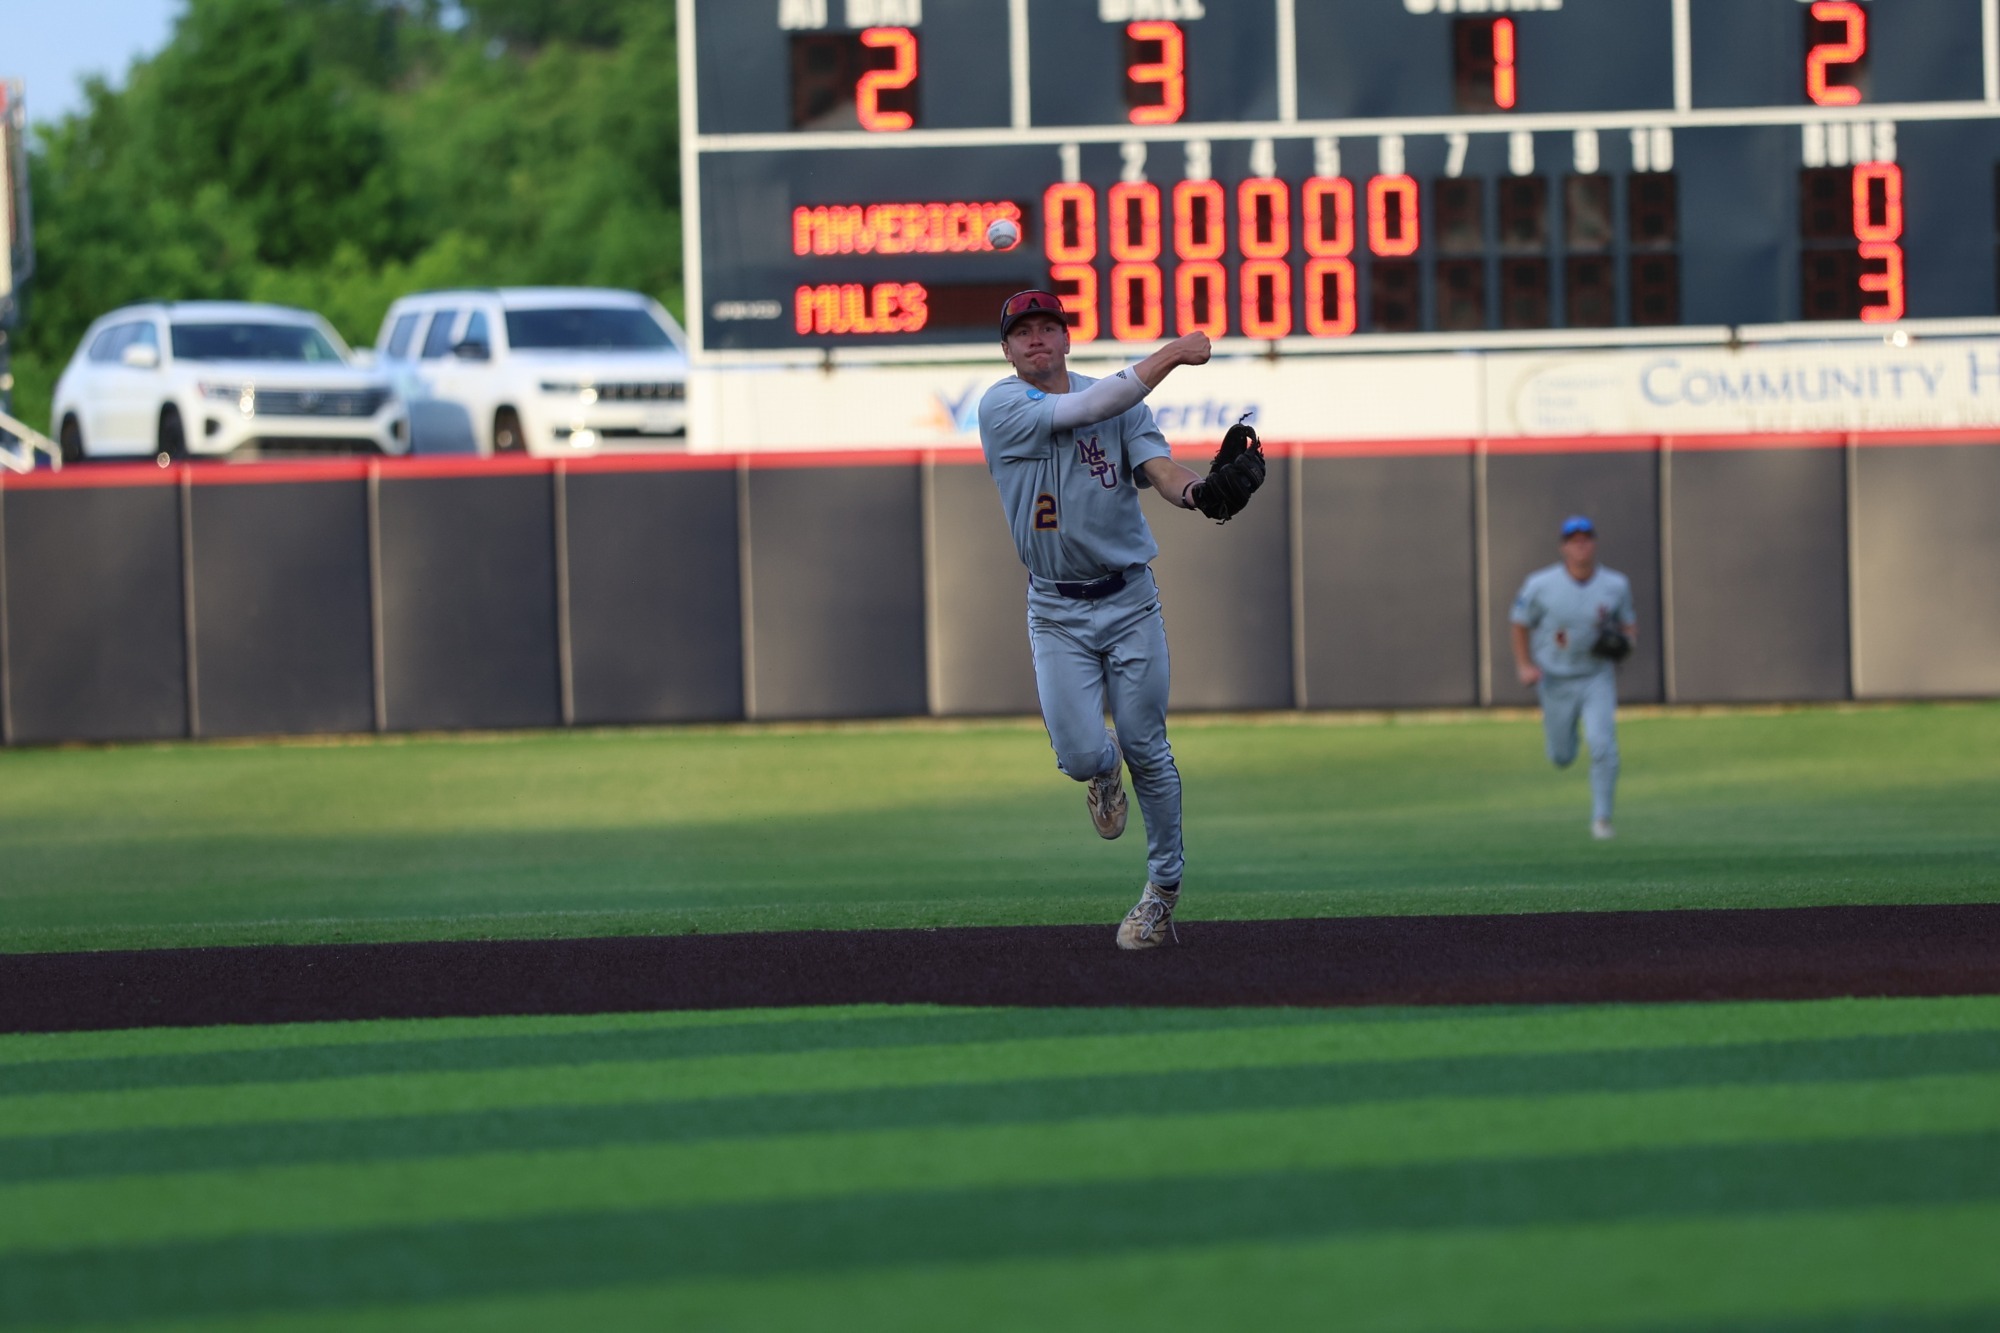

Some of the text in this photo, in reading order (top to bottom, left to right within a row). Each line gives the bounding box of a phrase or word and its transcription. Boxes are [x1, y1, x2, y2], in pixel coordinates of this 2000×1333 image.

[857, 27, 917, 131] 2
[1127, 21, 1184, 125] 3
[1493, 18, 1515, 109] 1
[1807, 2, 1866, 106] 2
[1059, 143, 1081, 182] 1
[1120, 142, 1148, 181] 2
[1185, 140, 1211, 179] 3
[1446, 133, 1469, 178] 7
[1044, 182, 1096, 264] 0
[1108, 181, 1161, 263] 0
[1173, 179, 1225, 262] 0
[1238, 177, 1290, 260] 0
[1302, 176, 1354, 258] 0
[1367, 174, 1418, 256] 0
[1853, 161, 1902, 242] 0
[795, 257, 1356, 343] MULES 3 0 0 0 0
[1858, 242, 1904, 324] 3
[1075, 436, 1118, 489] MSU
[1034, 493, 1058, 531] 2
